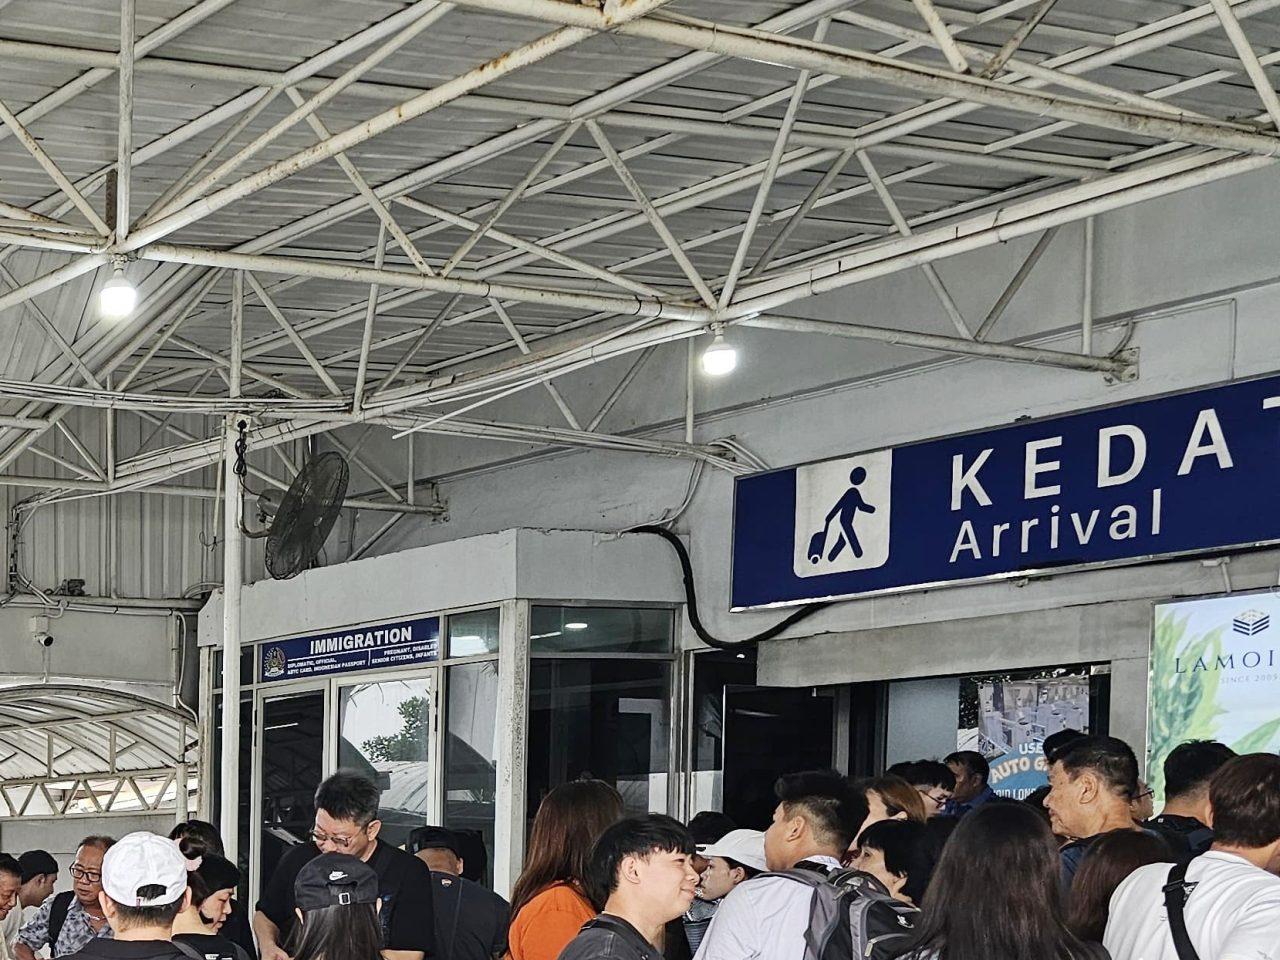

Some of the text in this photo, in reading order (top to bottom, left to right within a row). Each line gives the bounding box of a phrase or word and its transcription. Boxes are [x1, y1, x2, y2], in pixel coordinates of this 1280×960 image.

[949, 488, 1162, 563] Arrival
[310, 626, 412, 654] IMMIGRATION
[341, 660, 366, 668] PASSPORT
[1175, 649, 1275, 674] LAMOI
[1221, 676, 1249, 684] SINCE
[1019, 742, 1043, 755] USE
[991, 756, 1048, 783] AUTO G
